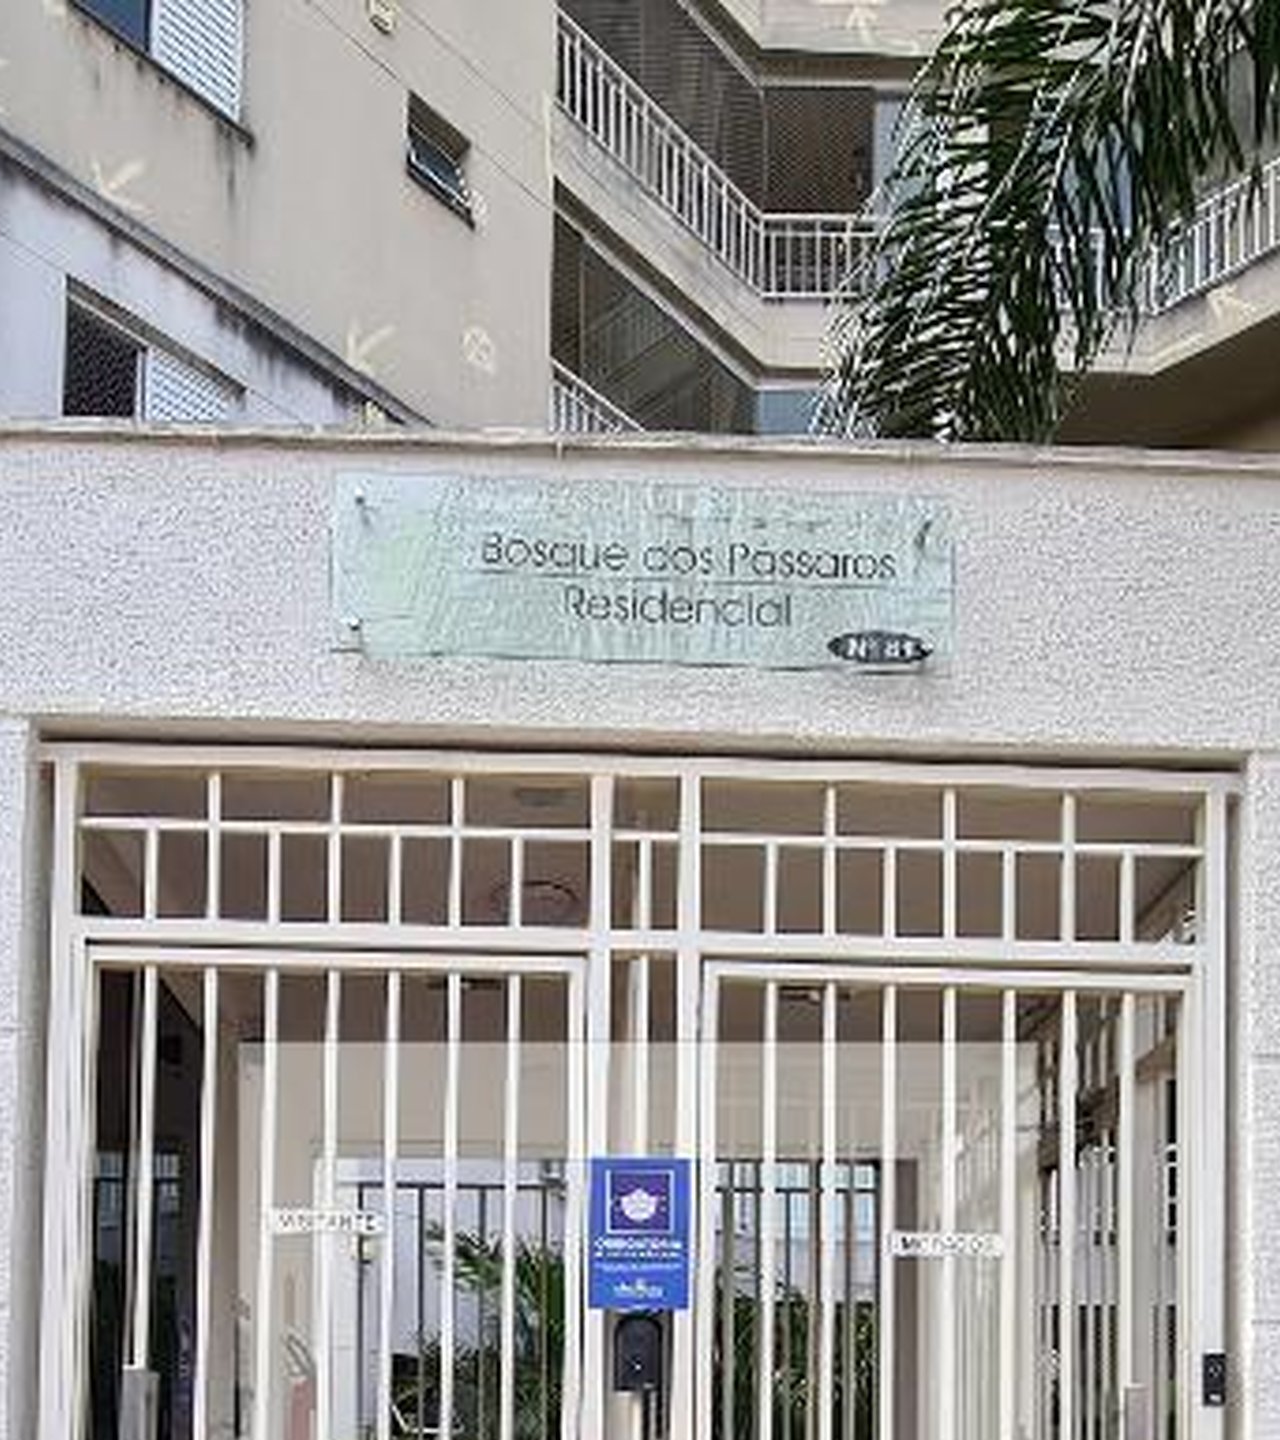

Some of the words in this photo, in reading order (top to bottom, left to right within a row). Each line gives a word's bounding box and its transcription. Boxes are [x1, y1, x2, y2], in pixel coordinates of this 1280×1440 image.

[481, 532, 630, 575] Bosque
[642, 539, 714, 575] dos
[564, 585, 793, 627] Residencial
